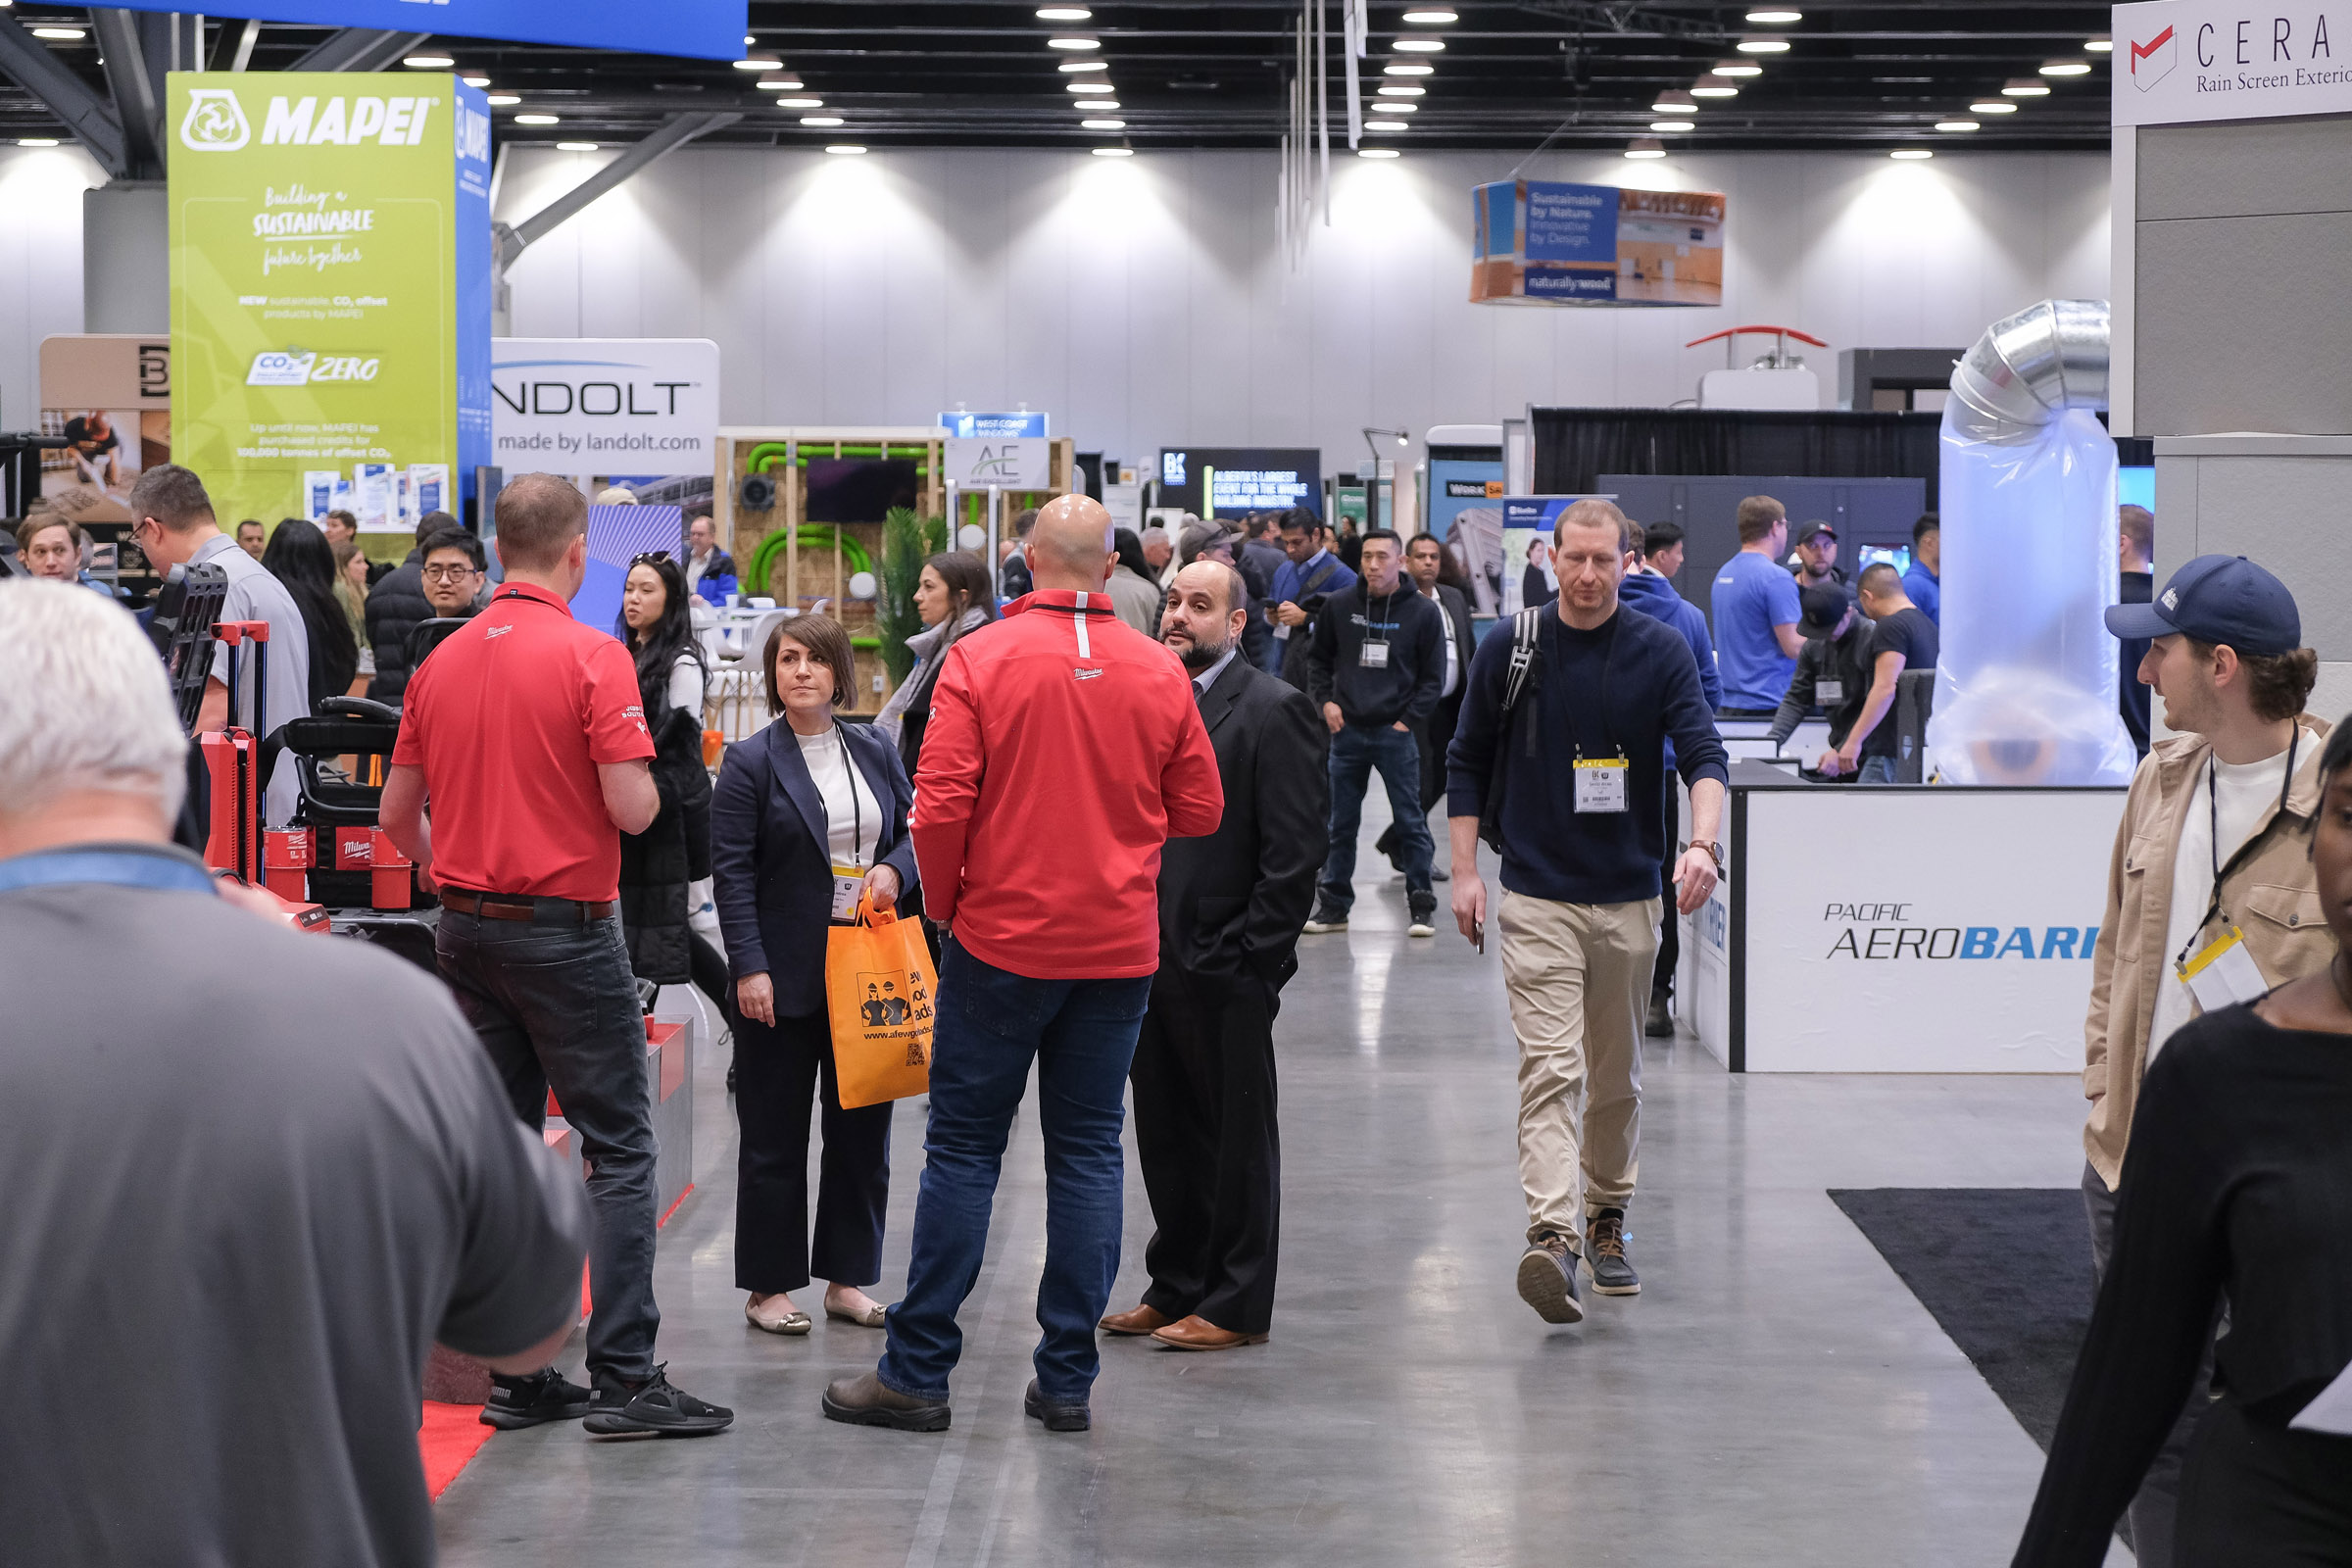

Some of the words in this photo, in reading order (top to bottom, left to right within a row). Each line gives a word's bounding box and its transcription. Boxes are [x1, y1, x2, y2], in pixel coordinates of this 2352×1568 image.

[2196, 15, 2330, 68] CERA
[2196, 74, 2231, 93] Rain
[2237, 72, 2289, 90] Screen
[261, 95, 431, 146] MAPEI
[265, 183, 330, 212] Building
[335, 190, 348, 202] a
[1530, 191, 1603, 207] Sustainable
[1530, 205, 1547, 220] by
[1548, 206, 1594, 220] Nature.
[253, 209, 374, 237] SUSTAINABLE
[1530, 219, 1591, 231] Innovative
[1529, 232, 1545, 245] by
[264, 246, 307, 276] future
[308, 242, 363, 272] together
[238, 295, 268, 306] NEW
[356, 295, 388, 306] offset
[264, 310, 312, 320] products
[314, 310, 325, 320] by
[328, 310, 364, 319] MAPEI
[311, 357, 380, 382] ZERO
[492, 381, 690, 415] NDOLT
[250, 423, 267, 434] Up
[269, 423, 293, 432] until
[321, 423, 358, 432] MAPEI
[360, 423, 379, 432] has
[259, 436, 316, 445] purchased
[318, 436, 353, 445] credits
[356, 435, 369, 445] for
[498, 432, 552, 450] made
[558, 432, 581, 453] by
[587, 432, 701, 451] landolt.com
[237, 447, 279, 458] 100,000
[281, 448, 319, 458] tonnes
[321, 447, 333, 458] of
[335, 447, 367, 458] offset
[1259, 470, 1298, 482] LARGEST
[1213, 482, 1241, 495] EVENT
[1242, 482, 1259, 495] FOR
[1260, 482, 1276, 495] THE
[1277, 482, 1308, 496] WHOLE
[1213, 494, 1251, 508] BUILDING
[343, 840, 370, 855] Milwa
[1824, 903, 1912, 921] PACIFIC
[914, 1003, 933, 1021] ads
